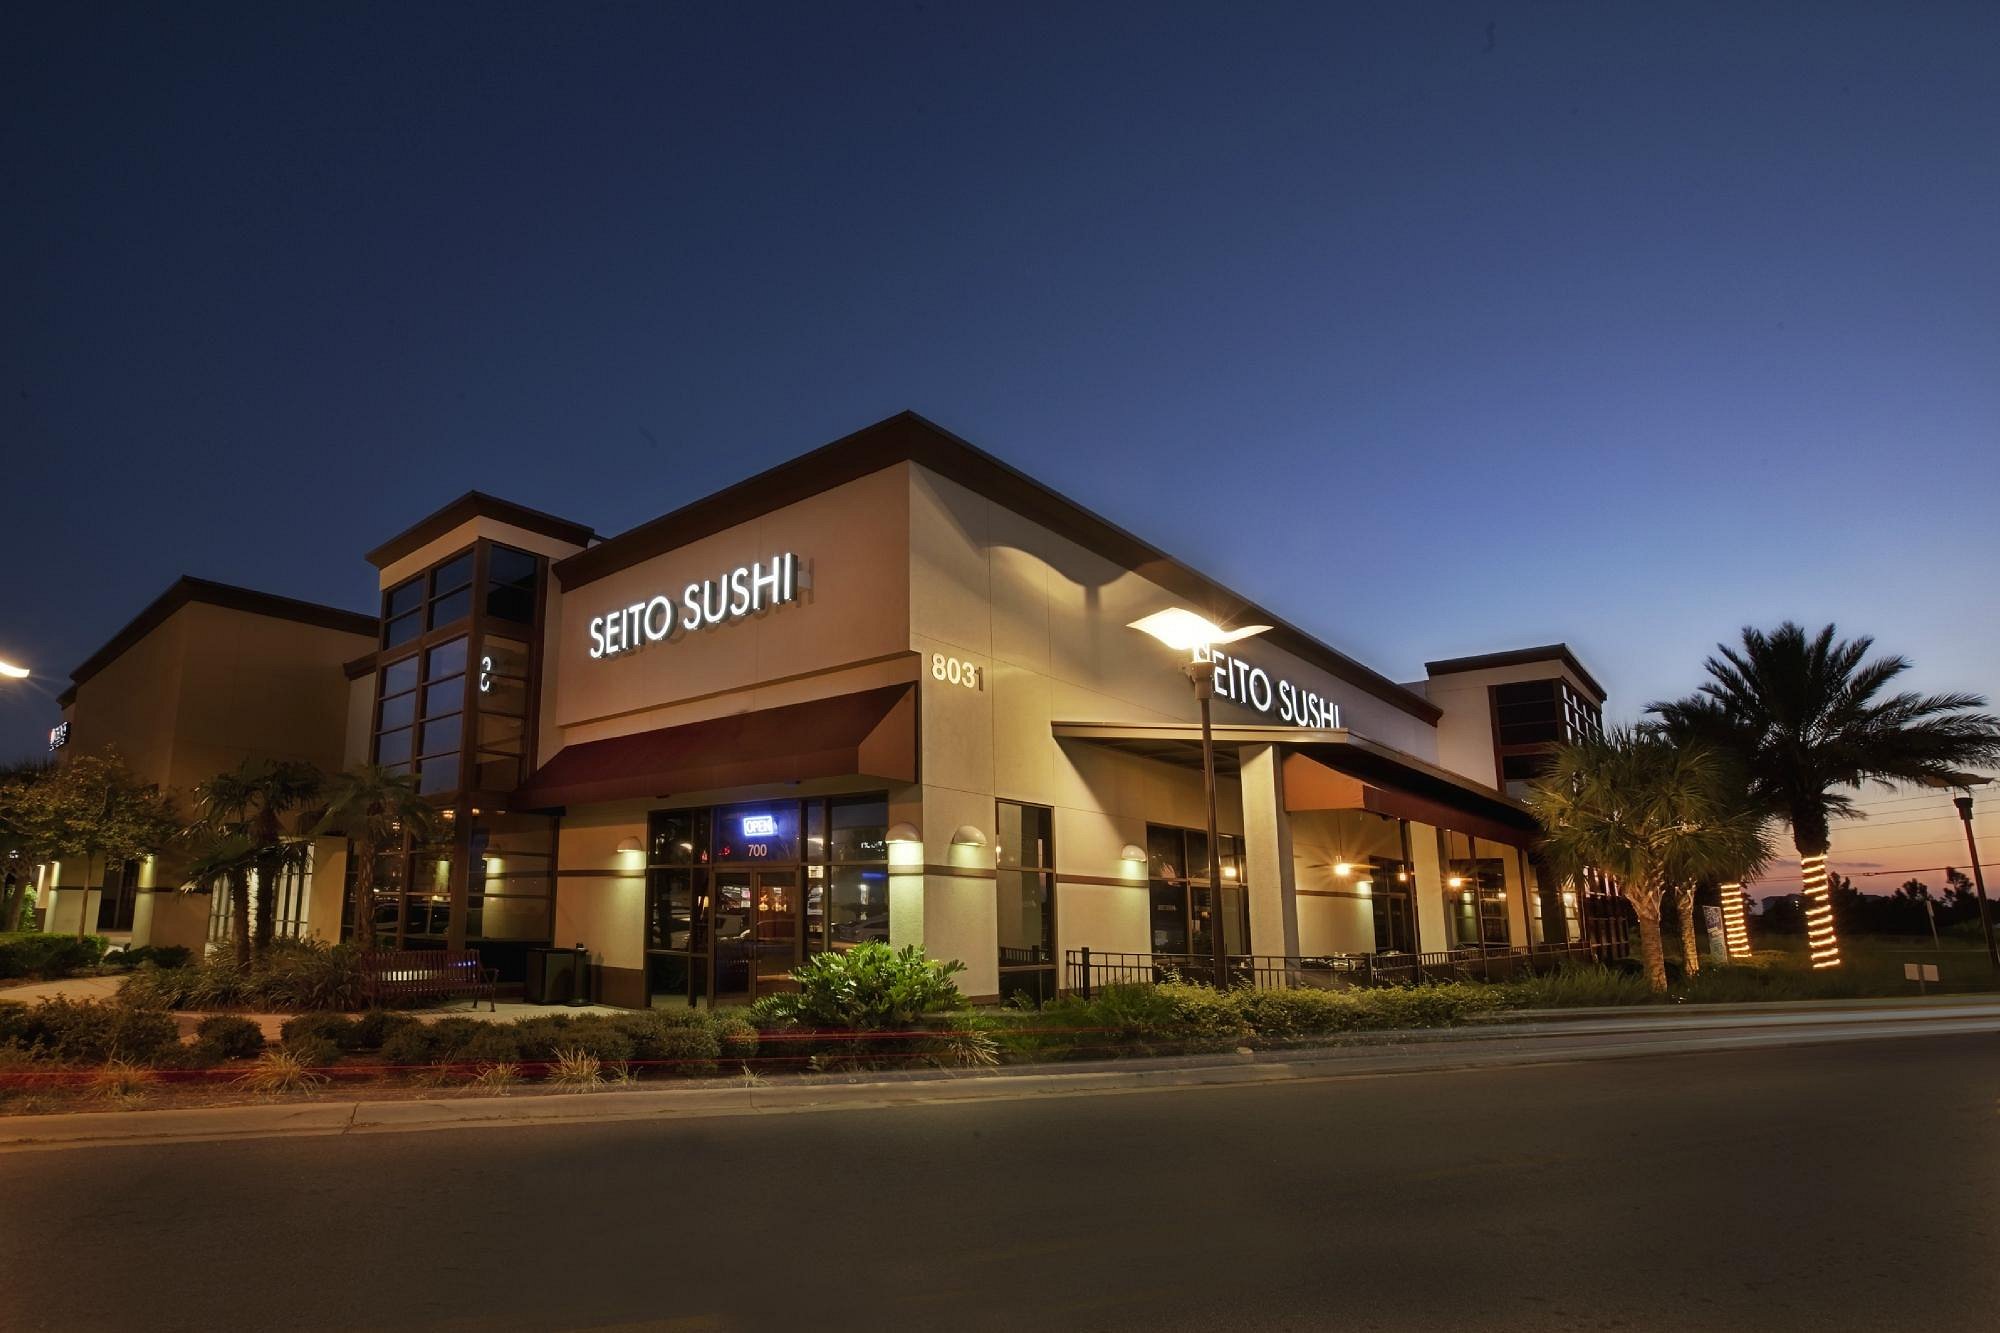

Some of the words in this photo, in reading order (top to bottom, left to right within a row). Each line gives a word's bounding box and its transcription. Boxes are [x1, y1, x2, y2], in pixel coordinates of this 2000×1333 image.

[590, 595, 673, 659] SEITO
[683, 551, 794, 631] SUSHI
[931, 652, 984, 692] 8031
[1200, 642, 1272, 712] EITO
[1278, 679, 1340, 728] SUSHI
[746, 819, 771, 833] OPEN
[748, 843, 768, 857] 700
